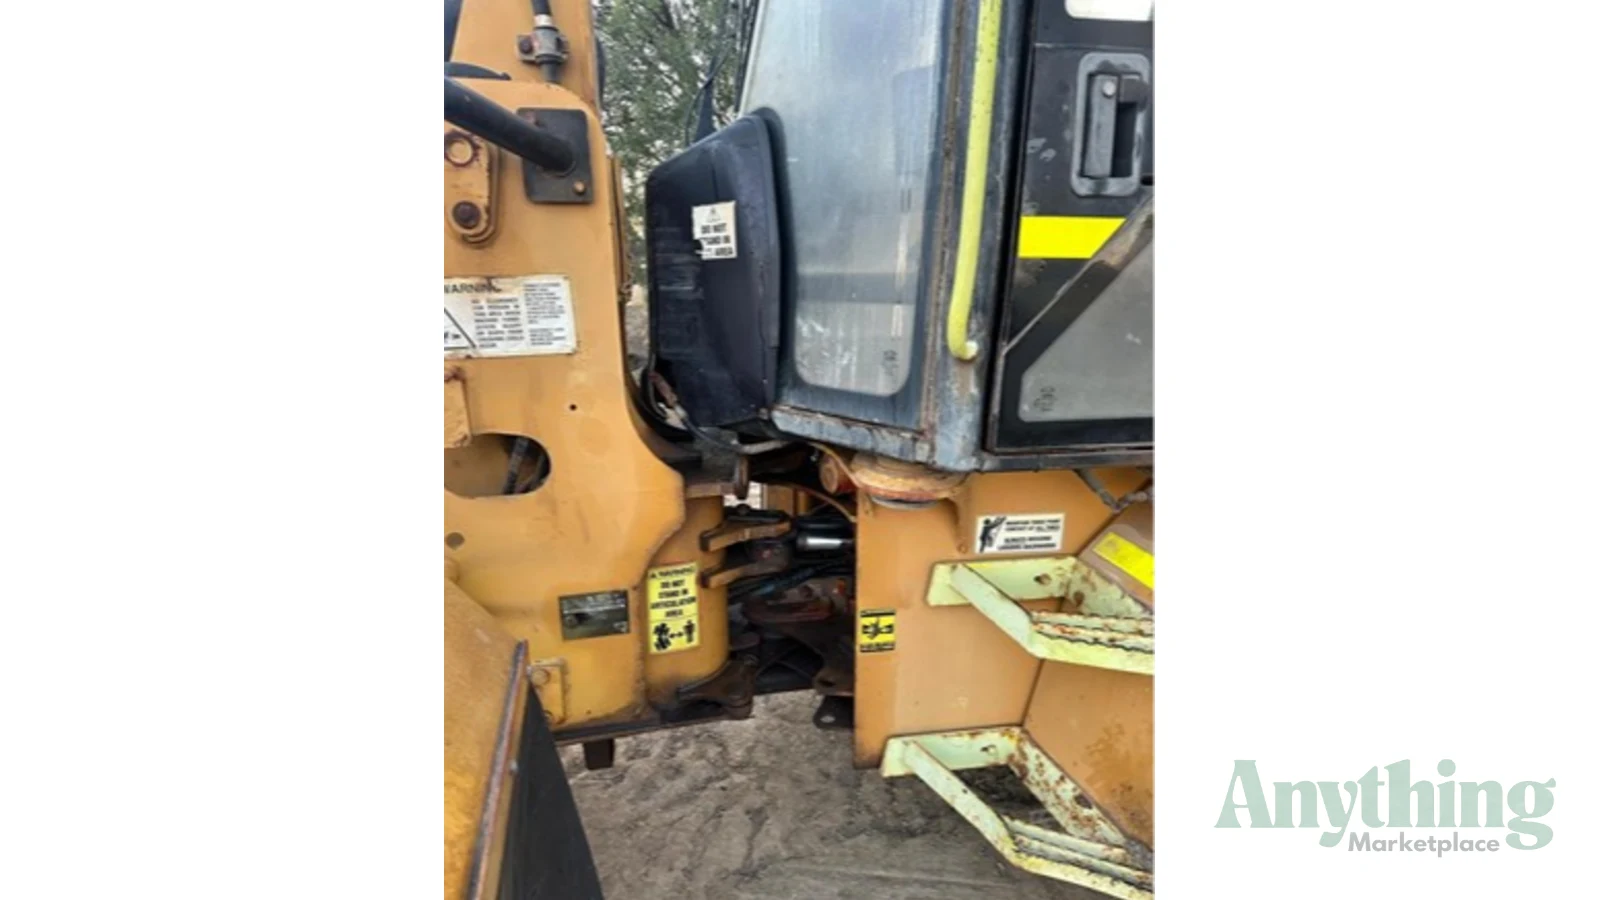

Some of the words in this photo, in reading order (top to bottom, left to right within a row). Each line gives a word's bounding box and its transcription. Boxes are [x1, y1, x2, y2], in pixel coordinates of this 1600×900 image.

[701, 223, 711, 234] DO
[713, 222, 727, 233] NOT
[660, 581, 670, 589] DO
[672, 579, 685, 587] NOT
